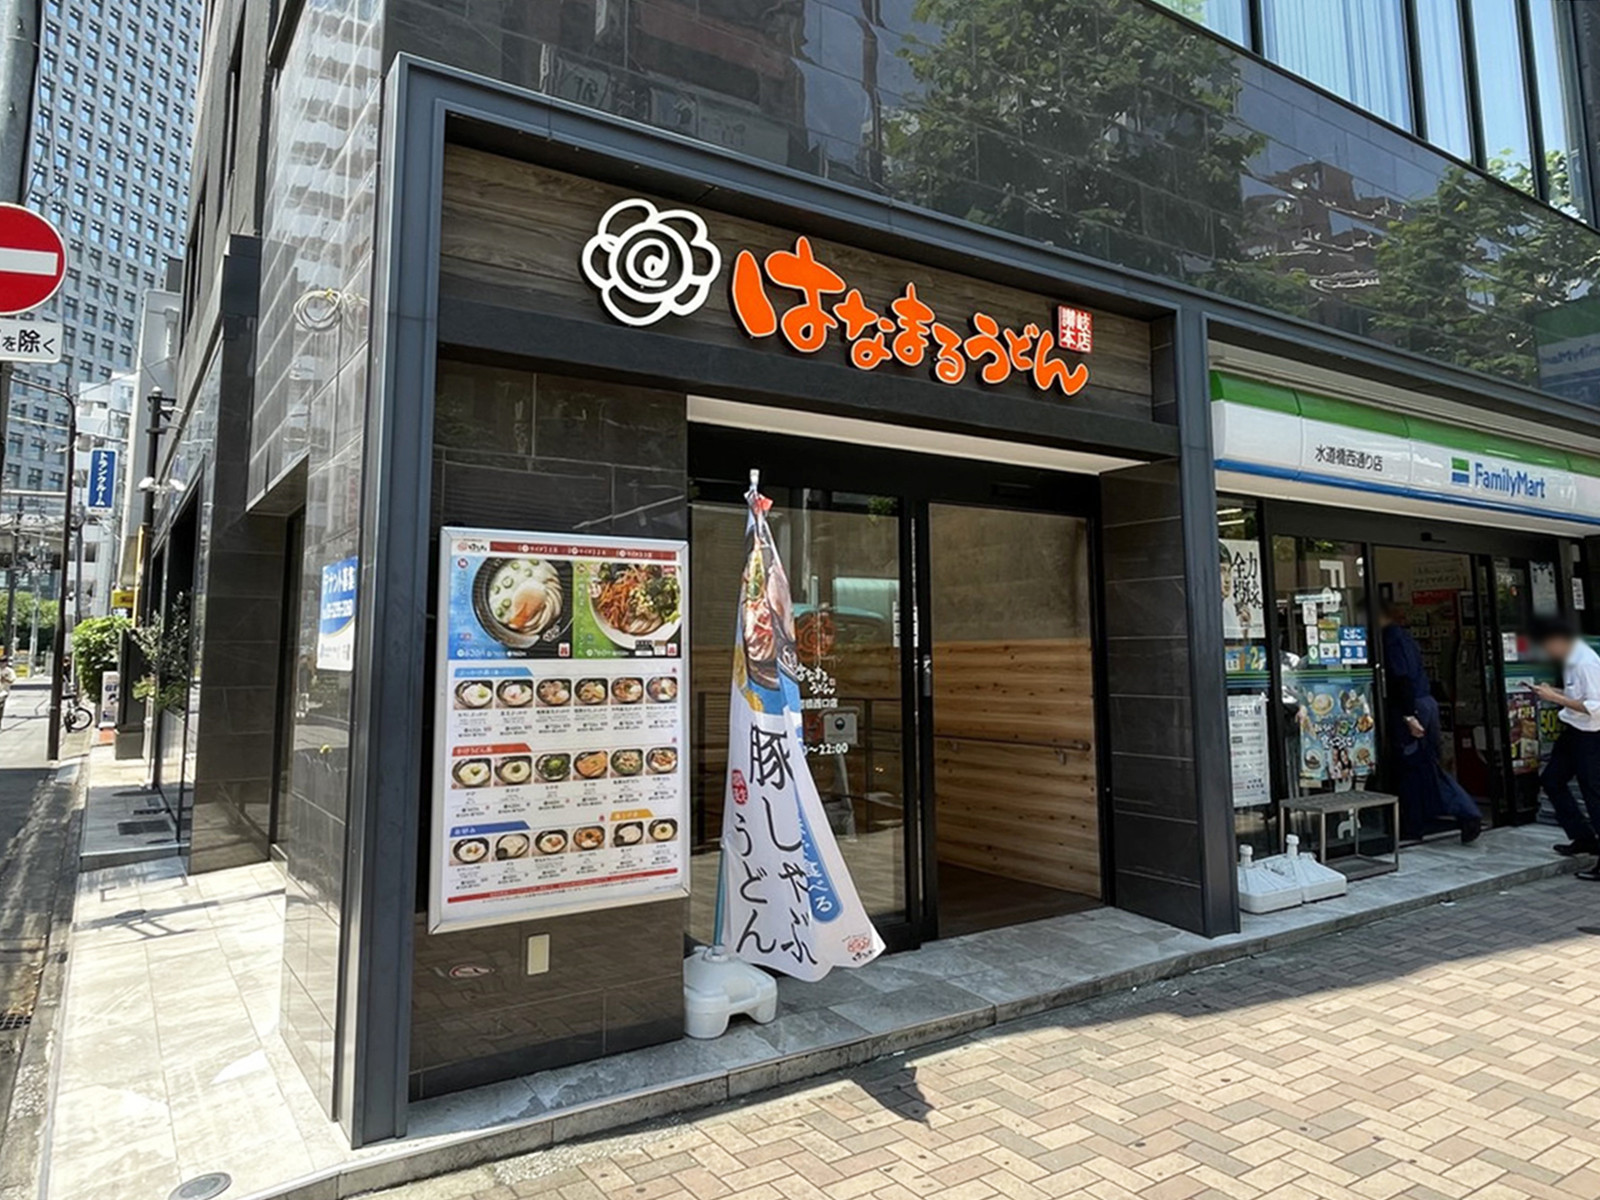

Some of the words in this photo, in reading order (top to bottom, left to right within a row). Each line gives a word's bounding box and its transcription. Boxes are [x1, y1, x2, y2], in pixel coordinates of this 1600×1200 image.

[731, 235, 1089, 396] はなまるうどん
[2, 329, 55, 354] を除く
[1314, 444, 1383, 472] 水道橋西通り店
[1474, 462, 1546, 499] FamilyMart
[734, 812, 777, 954] うどん
